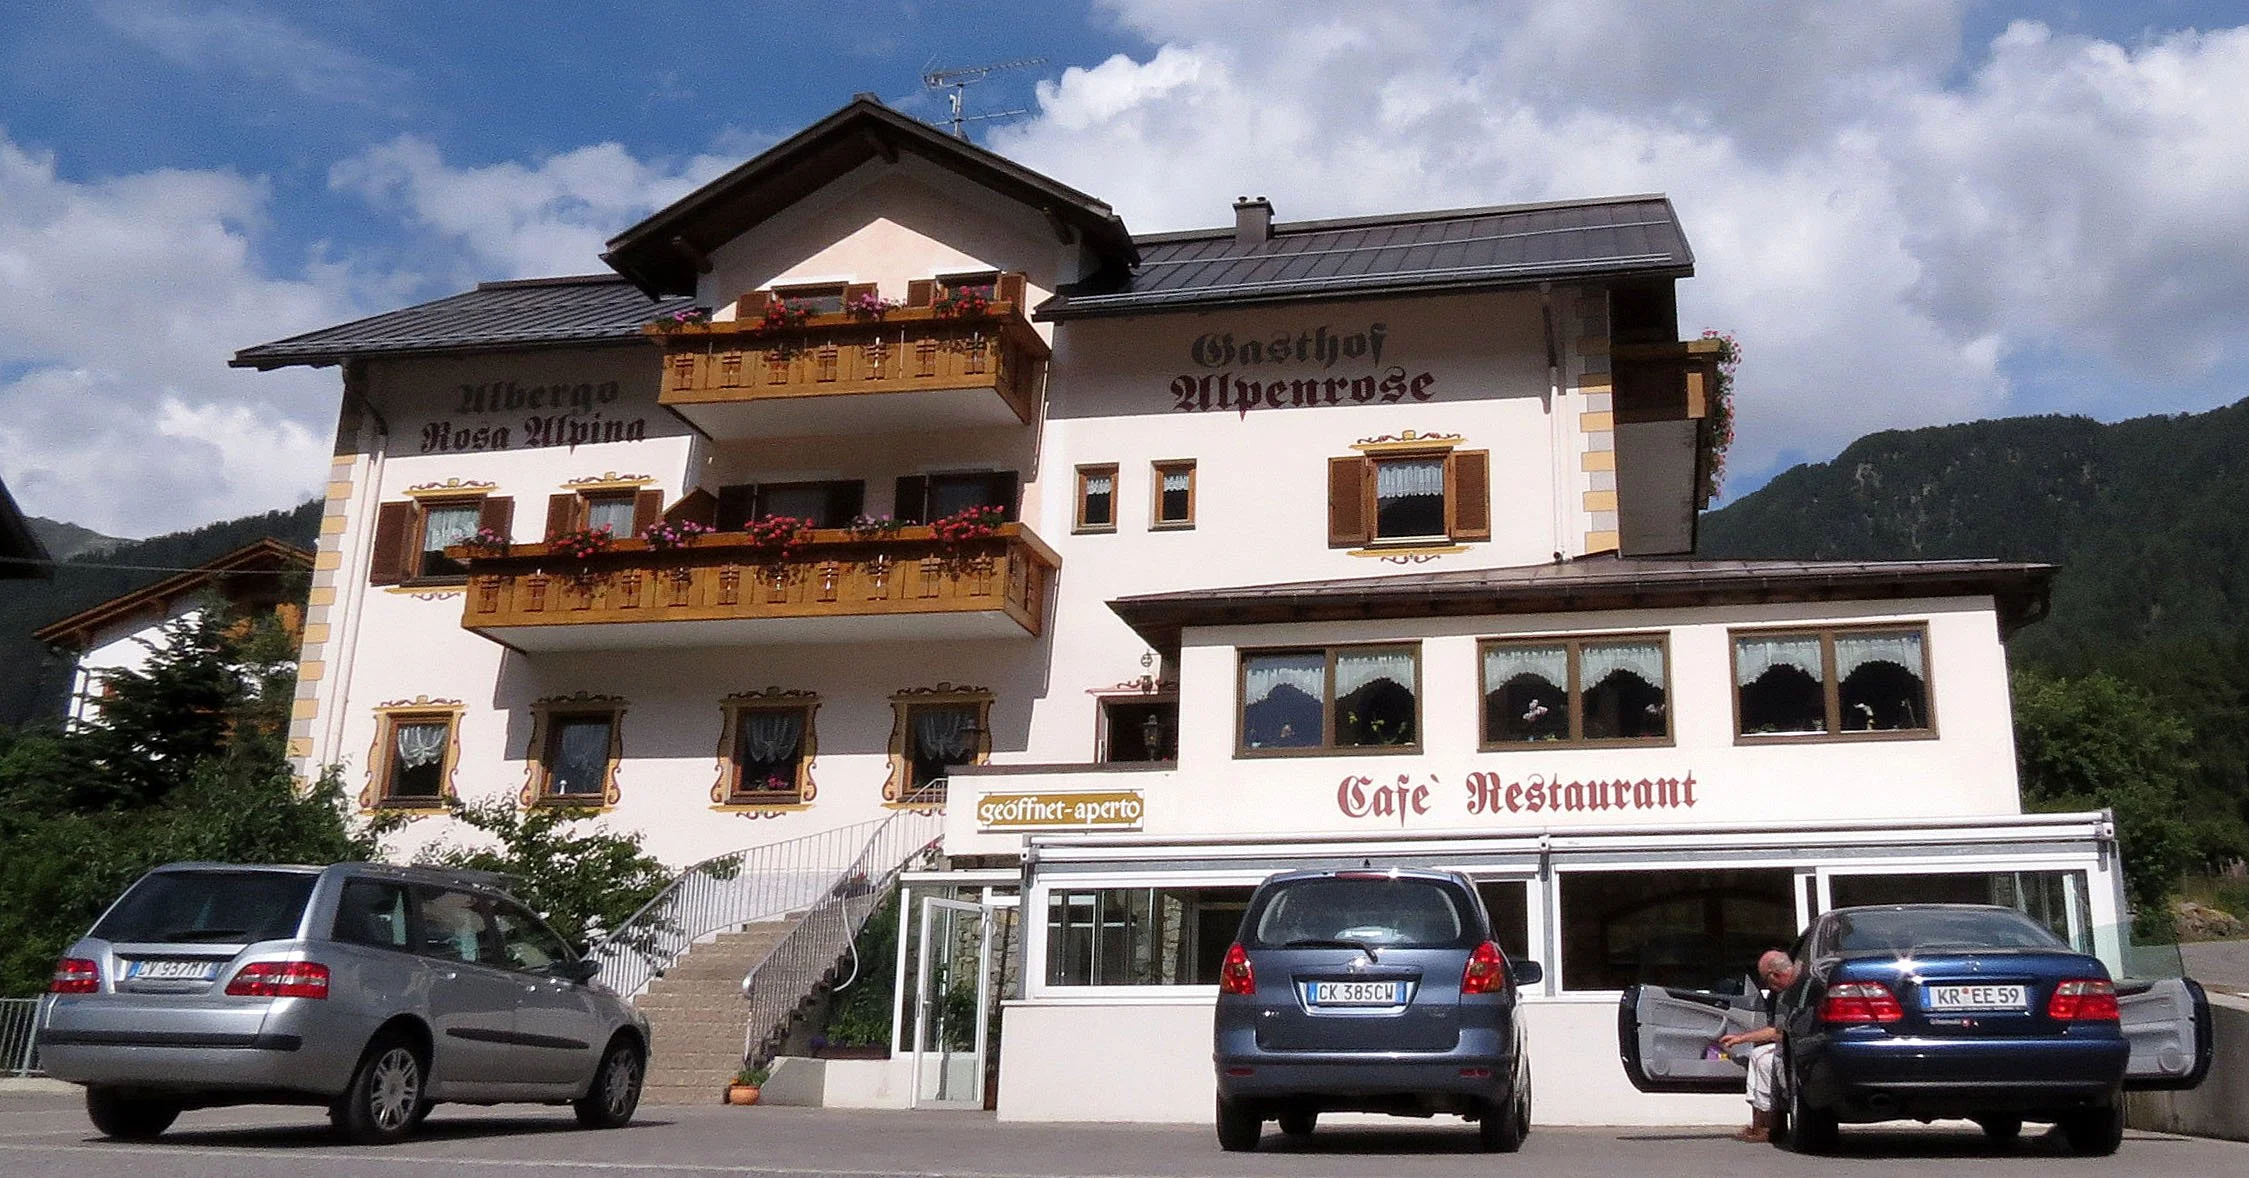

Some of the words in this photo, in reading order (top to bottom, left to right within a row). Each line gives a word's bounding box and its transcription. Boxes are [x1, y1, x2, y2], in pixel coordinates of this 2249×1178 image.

[1191, 322, 1388, 368] Gasthof
[455, 380, 620, 416] Albergo
[1170, 366, 1436, 420] Alpenrose
[421, 420, 512, 453] Rosa
[524, 412, 646, 455] Alpina
[1466, 769, 1699, 815] Restaurant
[1319, 984, 1338, 1001] CK
[1343, 984, 1394, 1001] 385CW
[1937, 988, 1960, 1005] KR
[1971, 988, 1995, 1004] EE
[1998, 987, 2020, 1004] 59
